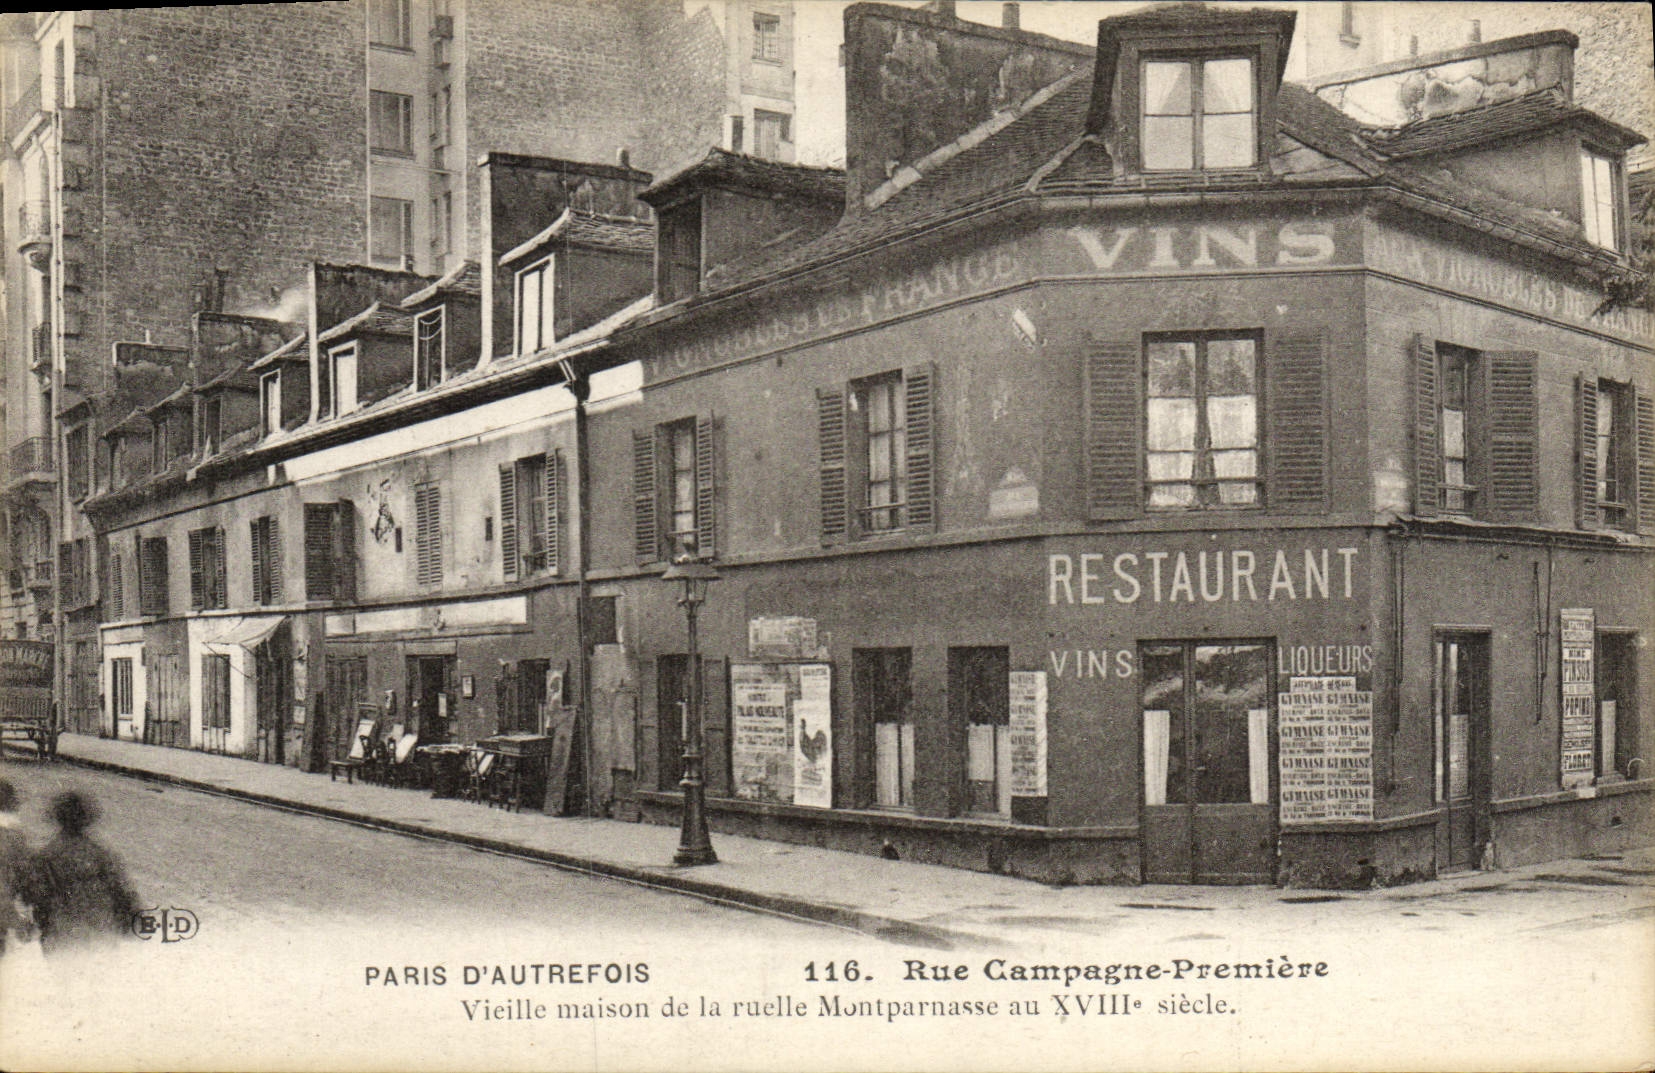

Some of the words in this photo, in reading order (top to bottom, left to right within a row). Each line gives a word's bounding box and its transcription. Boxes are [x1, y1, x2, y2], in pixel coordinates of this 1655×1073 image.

[1066, 221, 1336, 269] VINS
[1048, 547, 1358, 606] RESTAURANT
[1049, 649, 1134, 678] VINS
[1278, 645, 1374, 675] LIQUEURS
